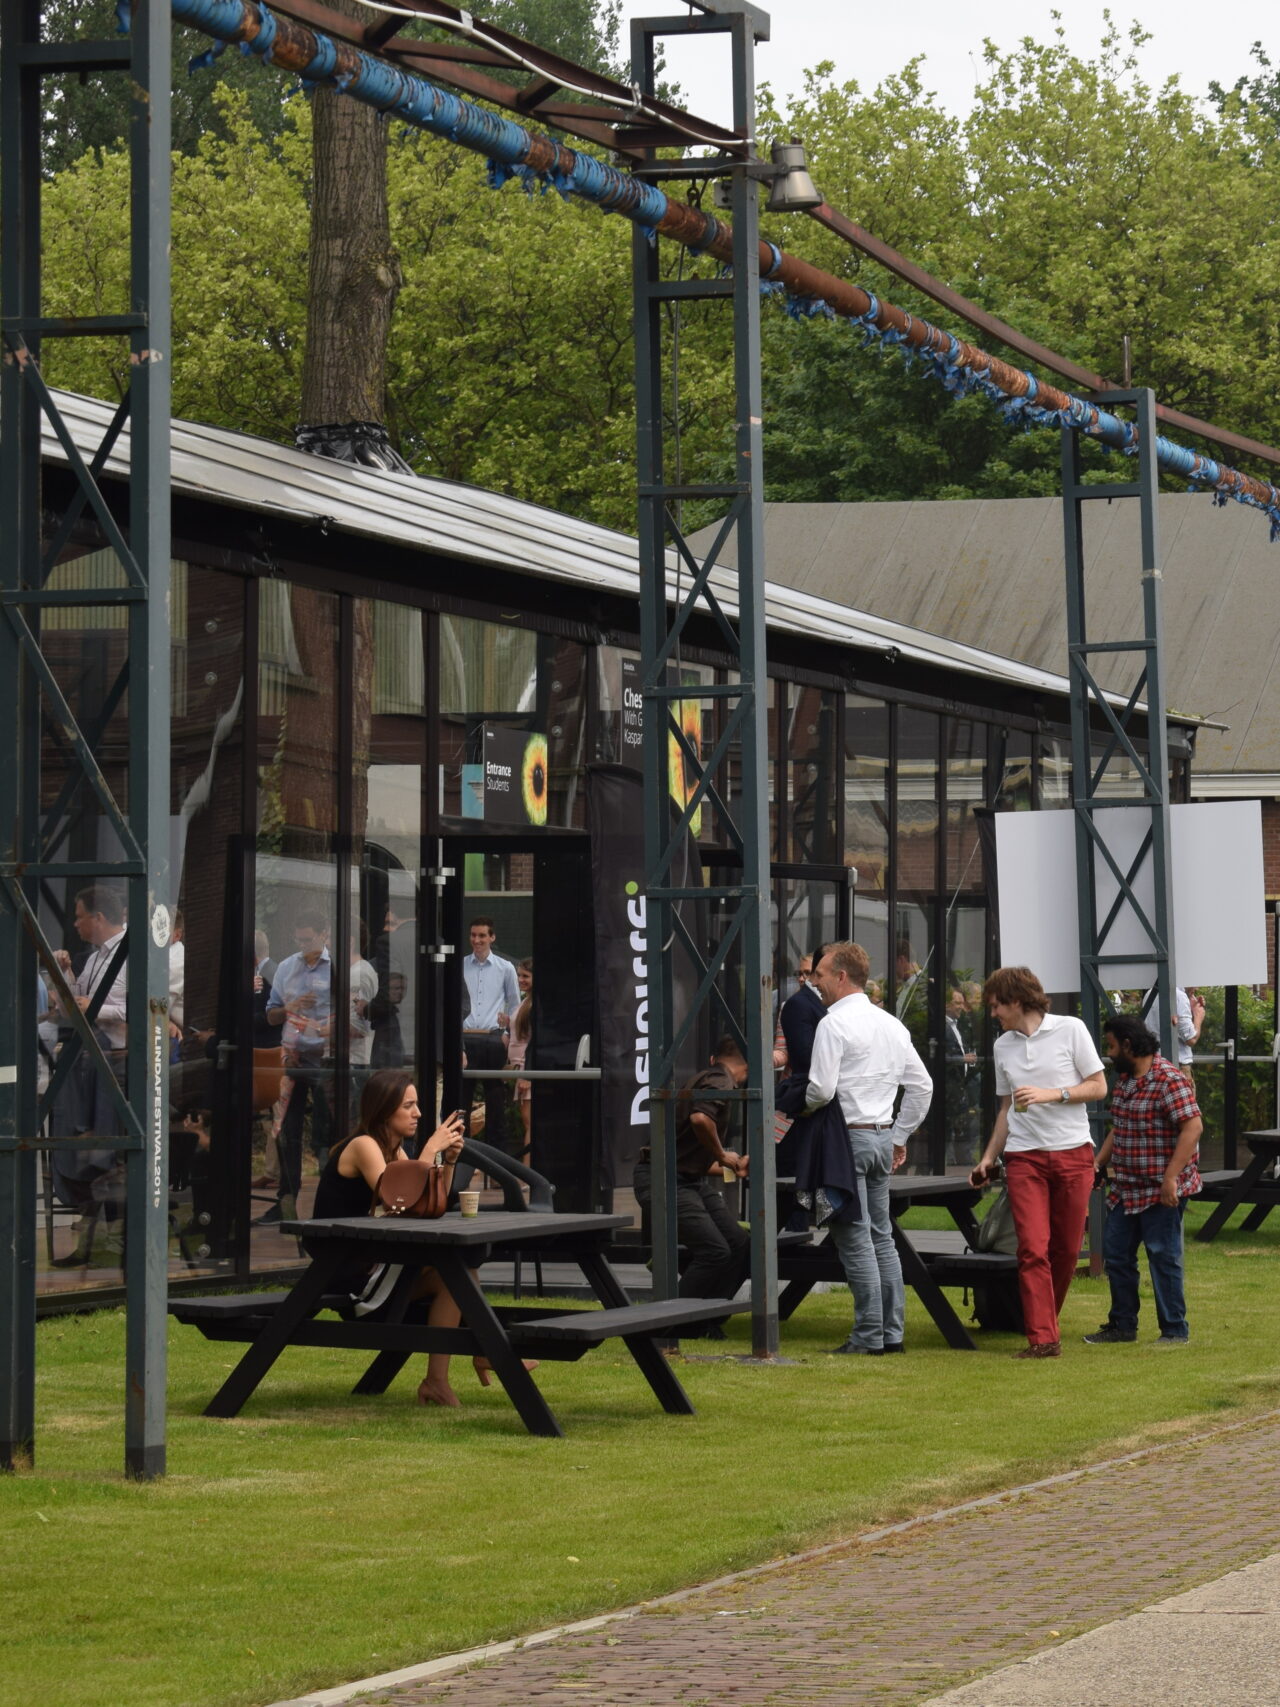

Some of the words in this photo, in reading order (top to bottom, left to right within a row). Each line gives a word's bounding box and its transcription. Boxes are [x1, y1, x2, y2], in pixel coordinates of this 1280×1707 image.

[624, 710, 637, 726] With
[487, 761, 511, 777] Entrance
[487, 776, 509, 792] Students
